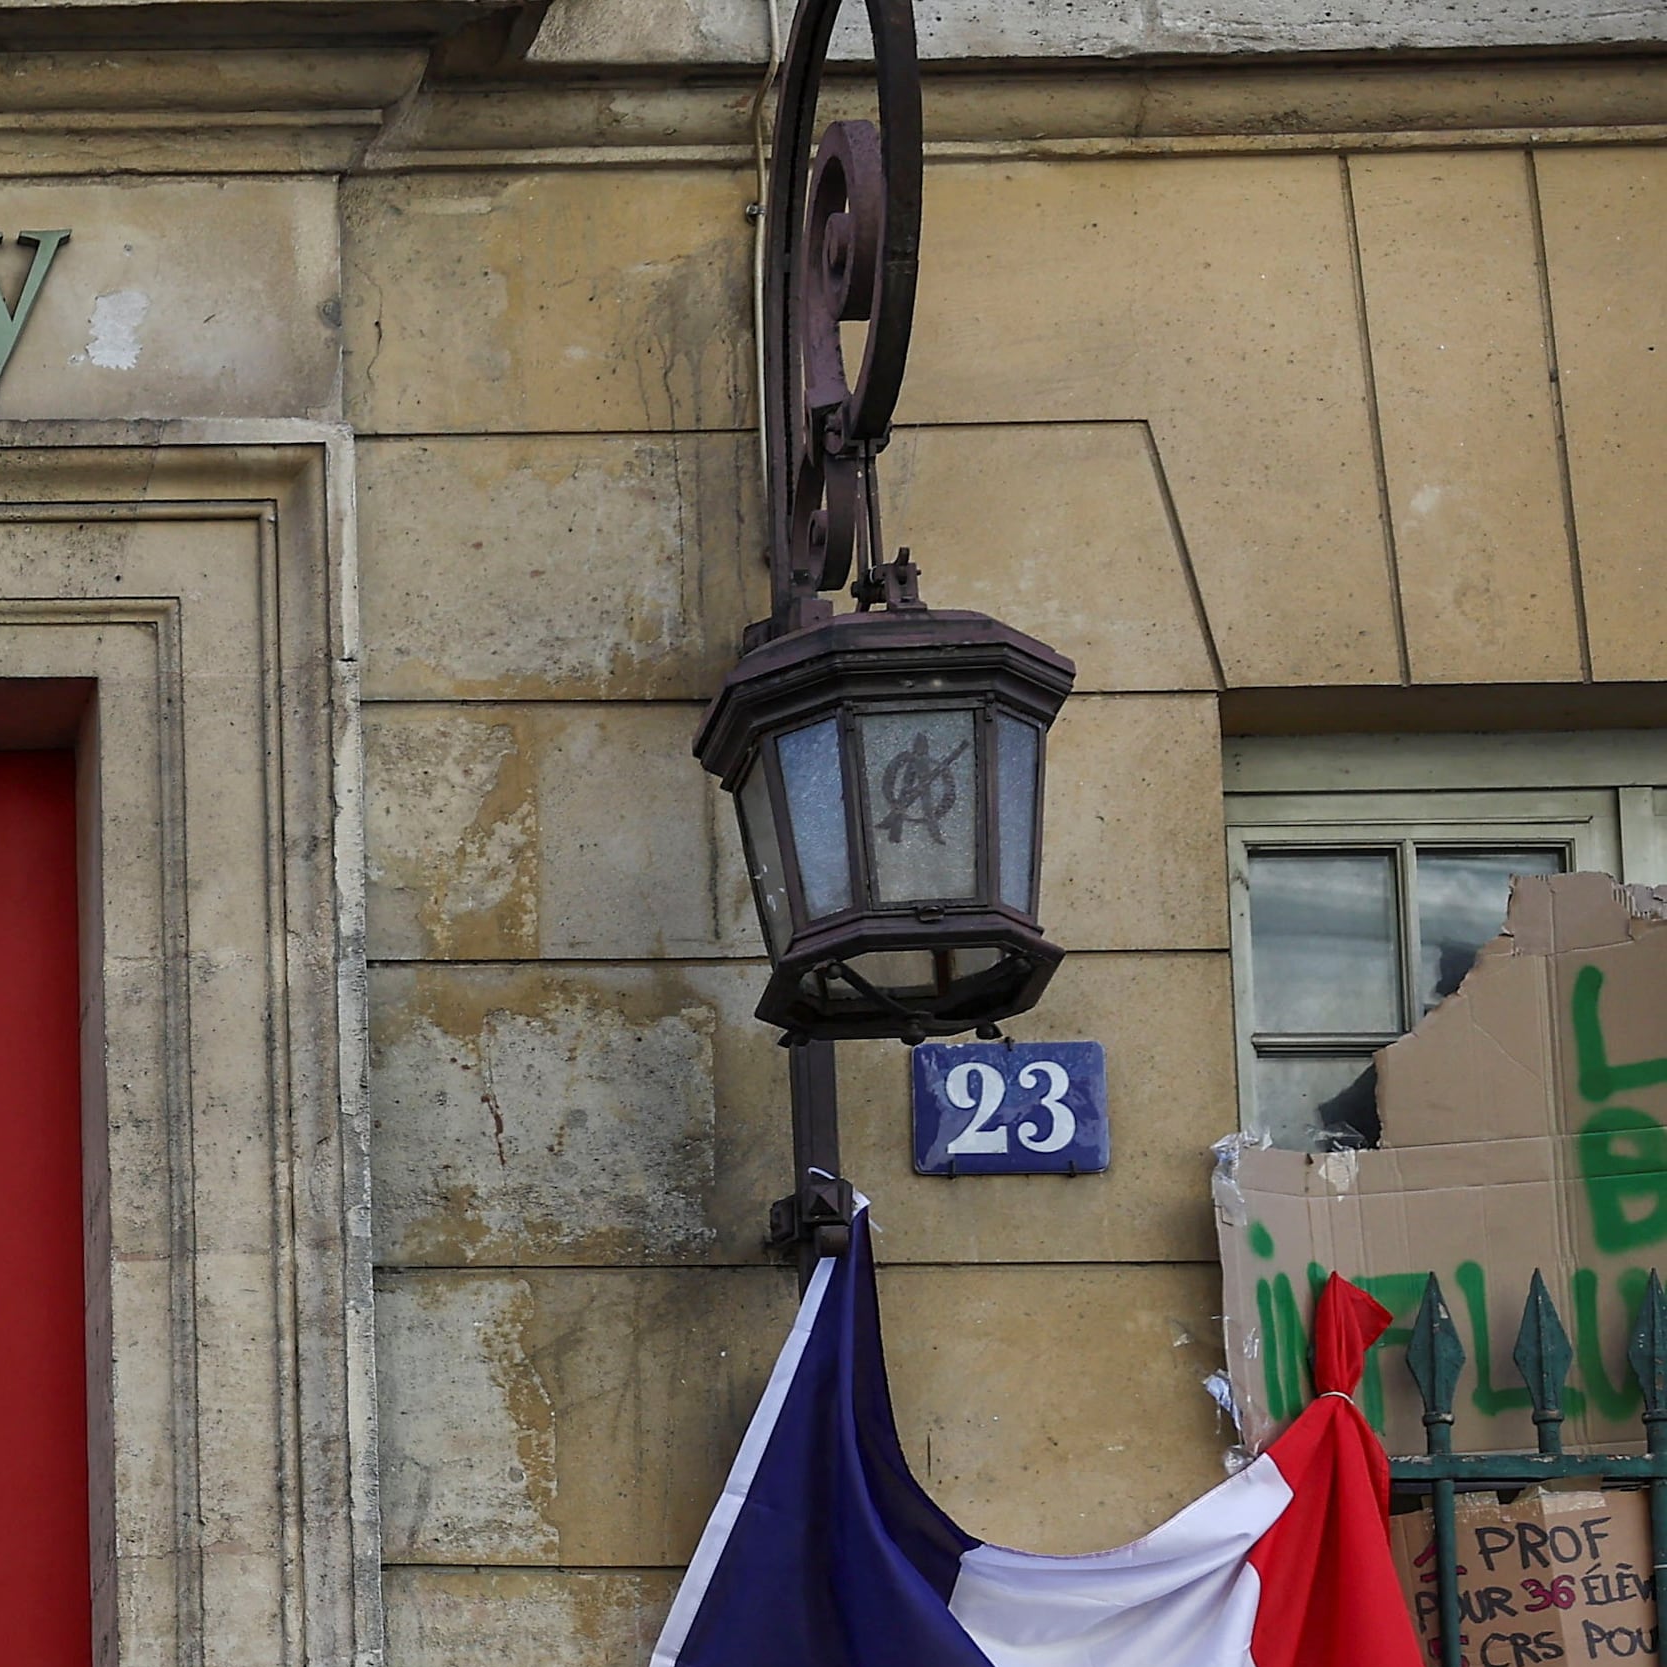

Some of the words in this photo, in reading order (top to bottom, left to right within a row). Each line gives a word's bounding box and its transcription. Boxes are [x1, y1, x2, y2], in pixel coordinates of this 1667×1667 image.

[946, 1061, 1076, 1154] 23
[1474, 1516, 1612, 1571] PROF
[1414, 1586, 1518, 1634] PUR
[1520, 1574, 1576, 1613] 36
[1581, 1619, 1659, 1660] POU
